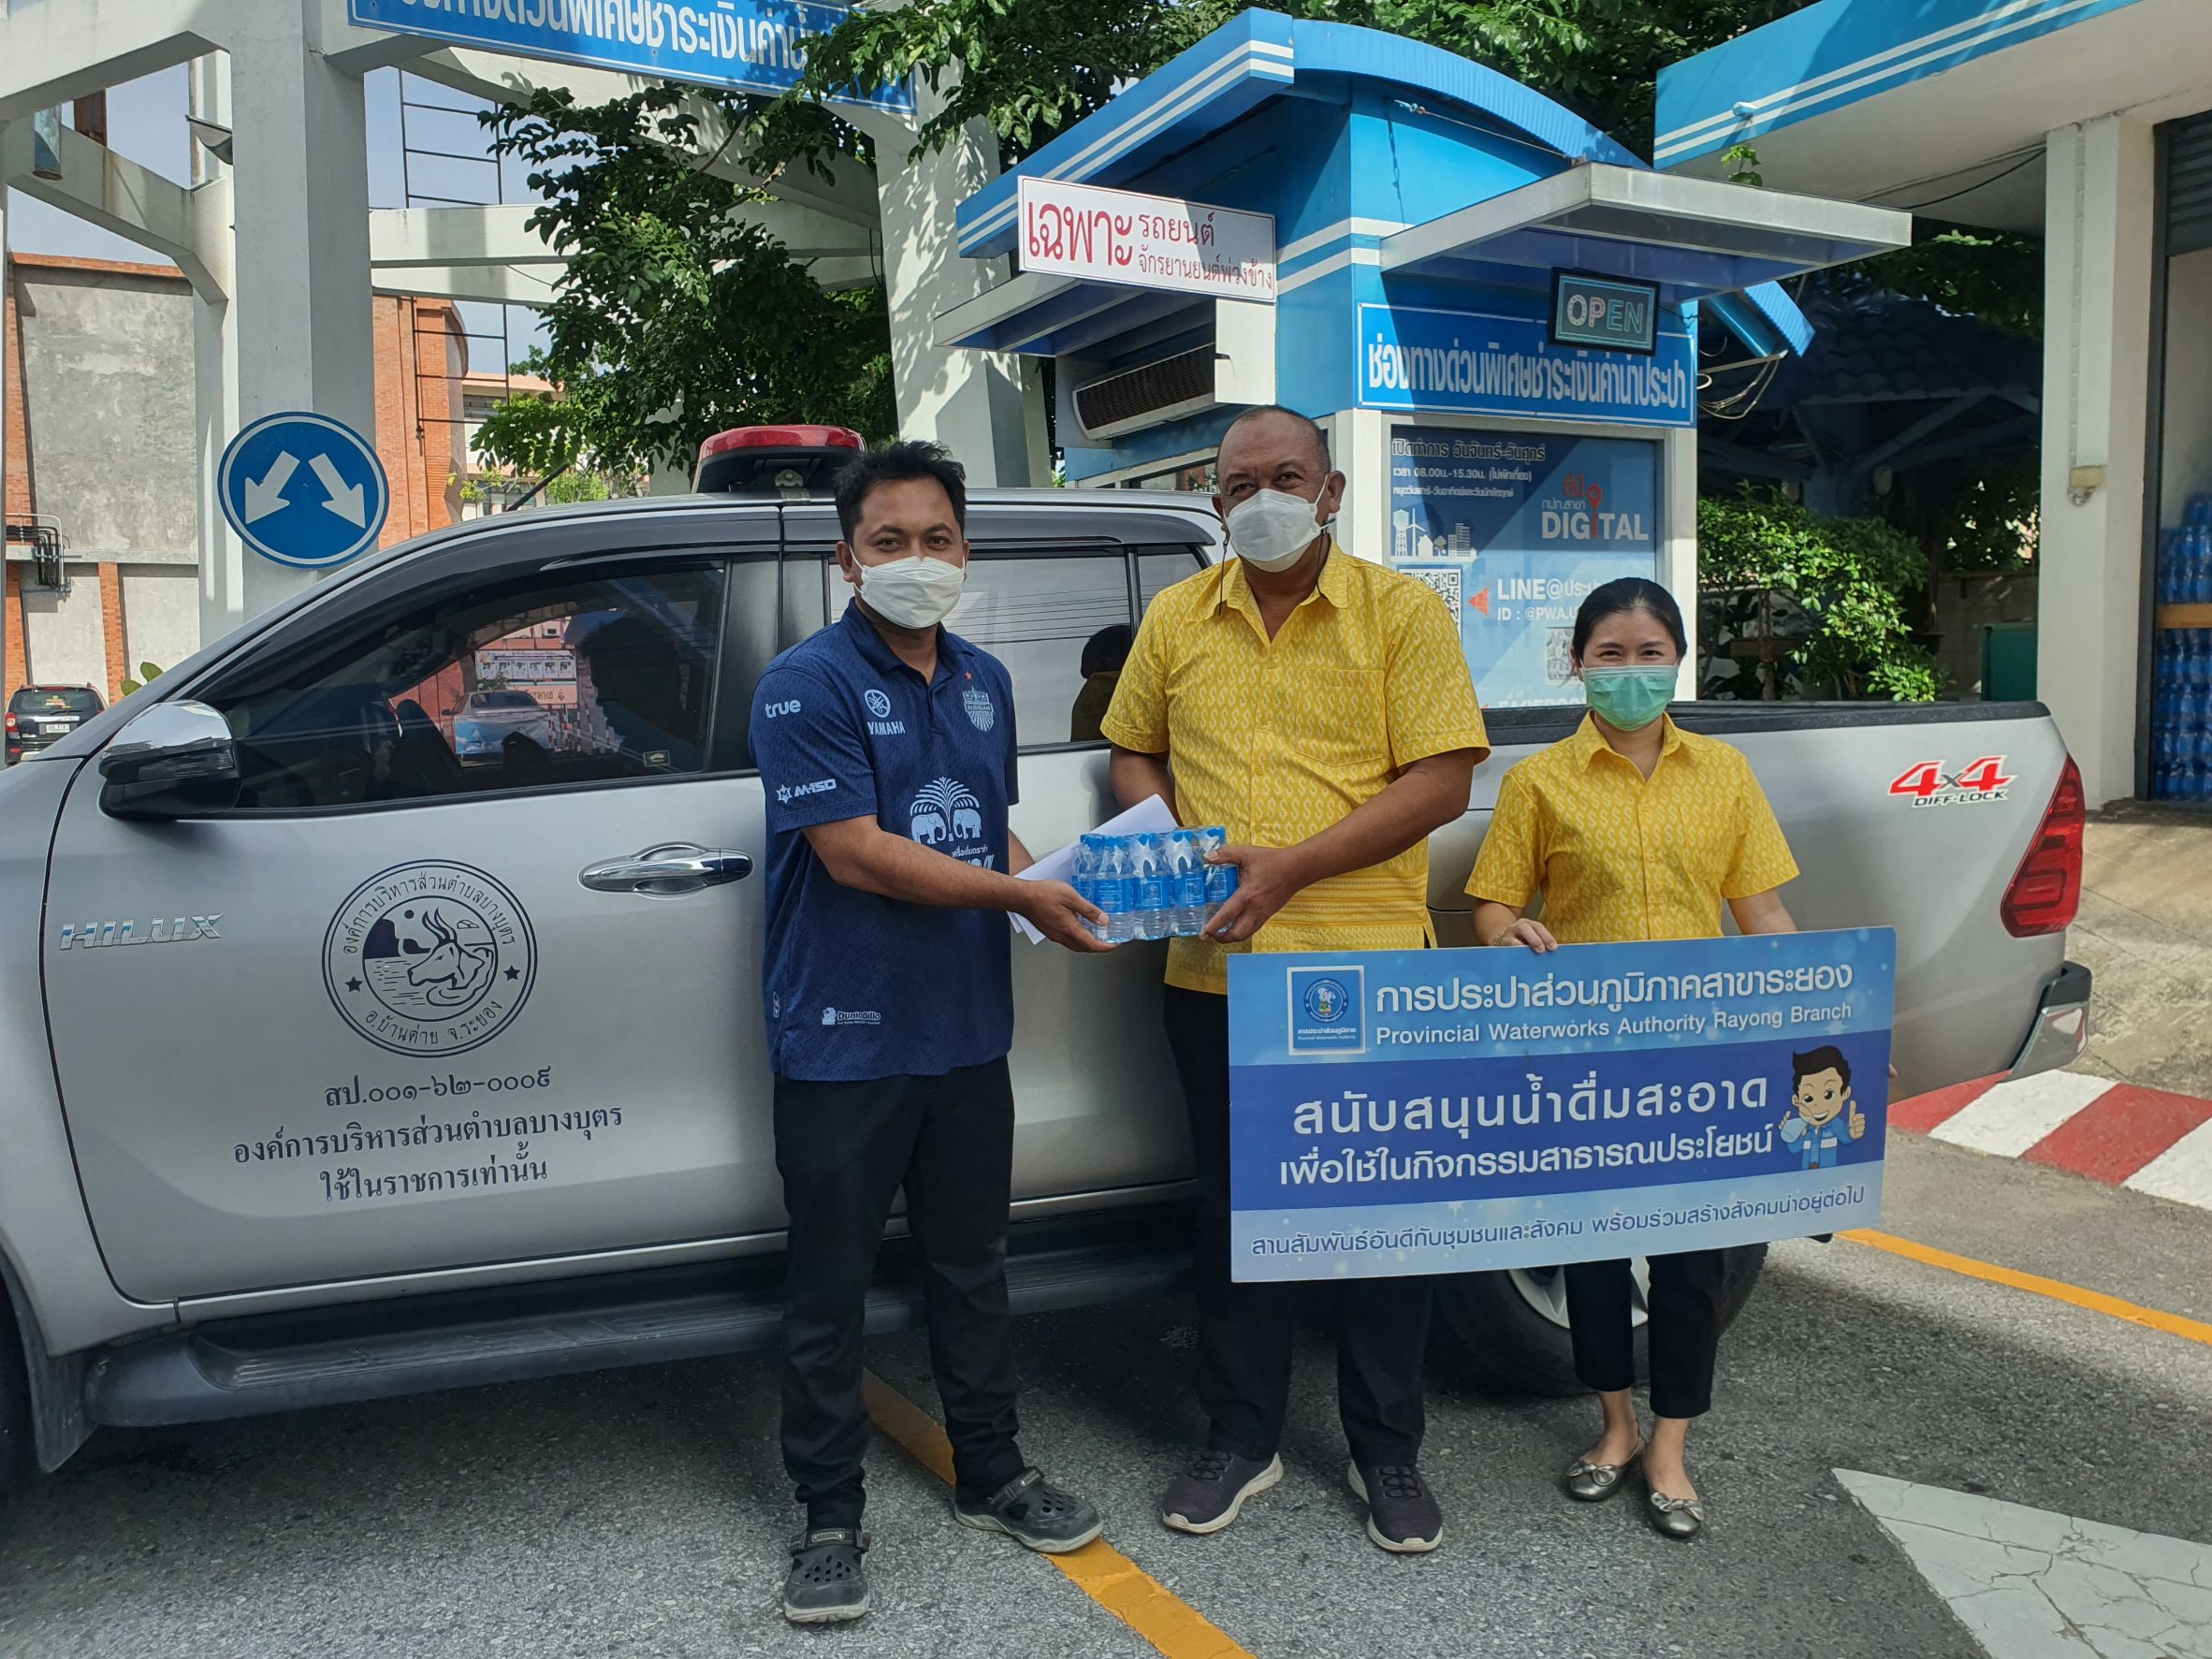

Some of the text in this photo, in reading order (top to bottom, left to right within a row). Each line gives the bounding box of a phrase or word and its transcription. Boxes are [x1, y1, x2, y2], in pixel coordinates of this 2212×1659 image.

[1028, 201, 1133, 267] เฉพาะ
[1138, 211, 1215, 247] รถยนต์
[1138, 244, 1273, 290] จักรยานยนต์พ่วงข้าง
[1566, 294, 1644, 334] OPEN
[1497, 607, 1512, 621] ID
[764, 699, 802, 719] true
[866, 720, 906, 736] YAMAHA
[794, 779, 837, 797] M-150
[1914, 790, 2008, 808] DIFF-LOCK
[60, 913, 225, 951] HILUX
[1375, 963, 1853, 1012] การประปาส่วนภูมิภาคสาขาระยอง
[366, 1000, 502, 1045] อ.บ้านค่าย จ.ระยอง
[1376, 1002, 1852, 1045] Provincial Waterworks Authority Rayong Branch
[1292, 1070, 1768, 1140] สนับสนุนน้ำดื่มสะอาด
[234, 1105, 623, 1163] องค์การบริหารส่วนตำบลบางบุตร
[1280, 1124, 1774, 1186] เพื่อใช้ในกิจกรรมสาธารณประโยชน์
[320, 1141, 548, 1202] ใช้ในราชการเท่านั้น
[1252, 1185, 1866, 1256] สานสัมพันธ์อันดีกับชุมชนและสังคม พร้อมร่วมสร้างสังคมน่าอยู่ต่อไป
